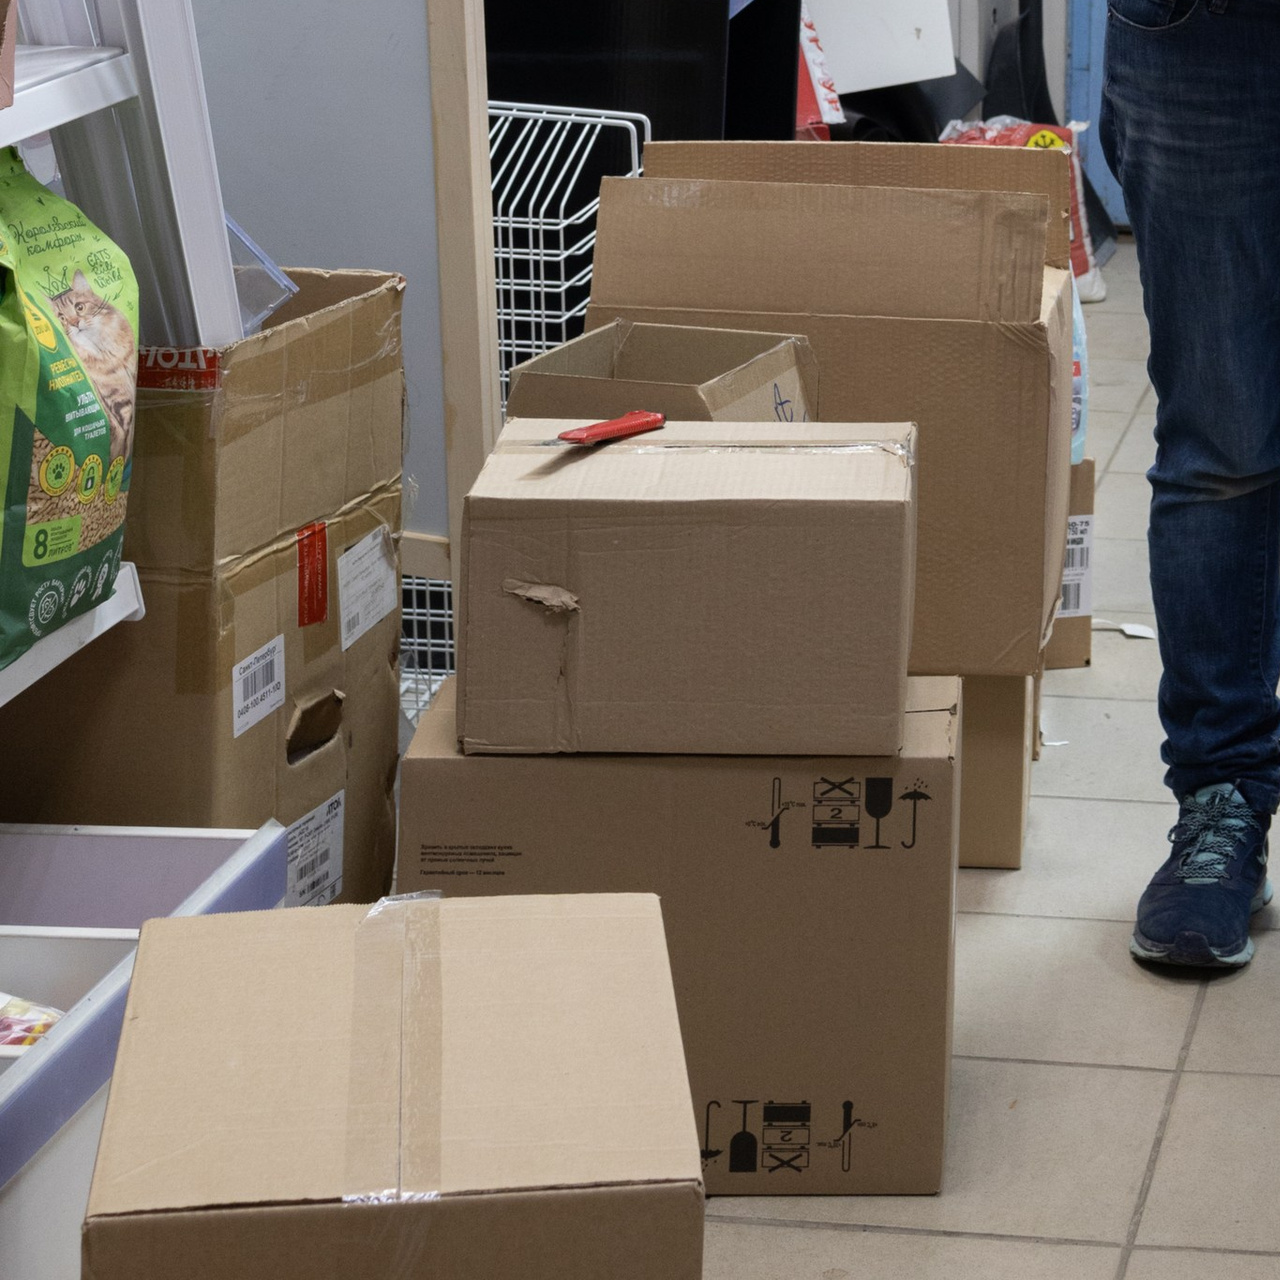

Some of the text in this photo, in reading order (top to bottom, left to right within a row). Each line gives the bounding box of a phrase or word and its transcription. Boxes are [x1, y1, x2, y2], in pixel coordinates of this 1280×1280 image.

[87, 248, 111, 268] CATS
[94, 267, 123, 289] World
[33, 528, 48, 559] 8
[829, 808, 843, 820] 2
[780, 1130, 793, 1142] 2
